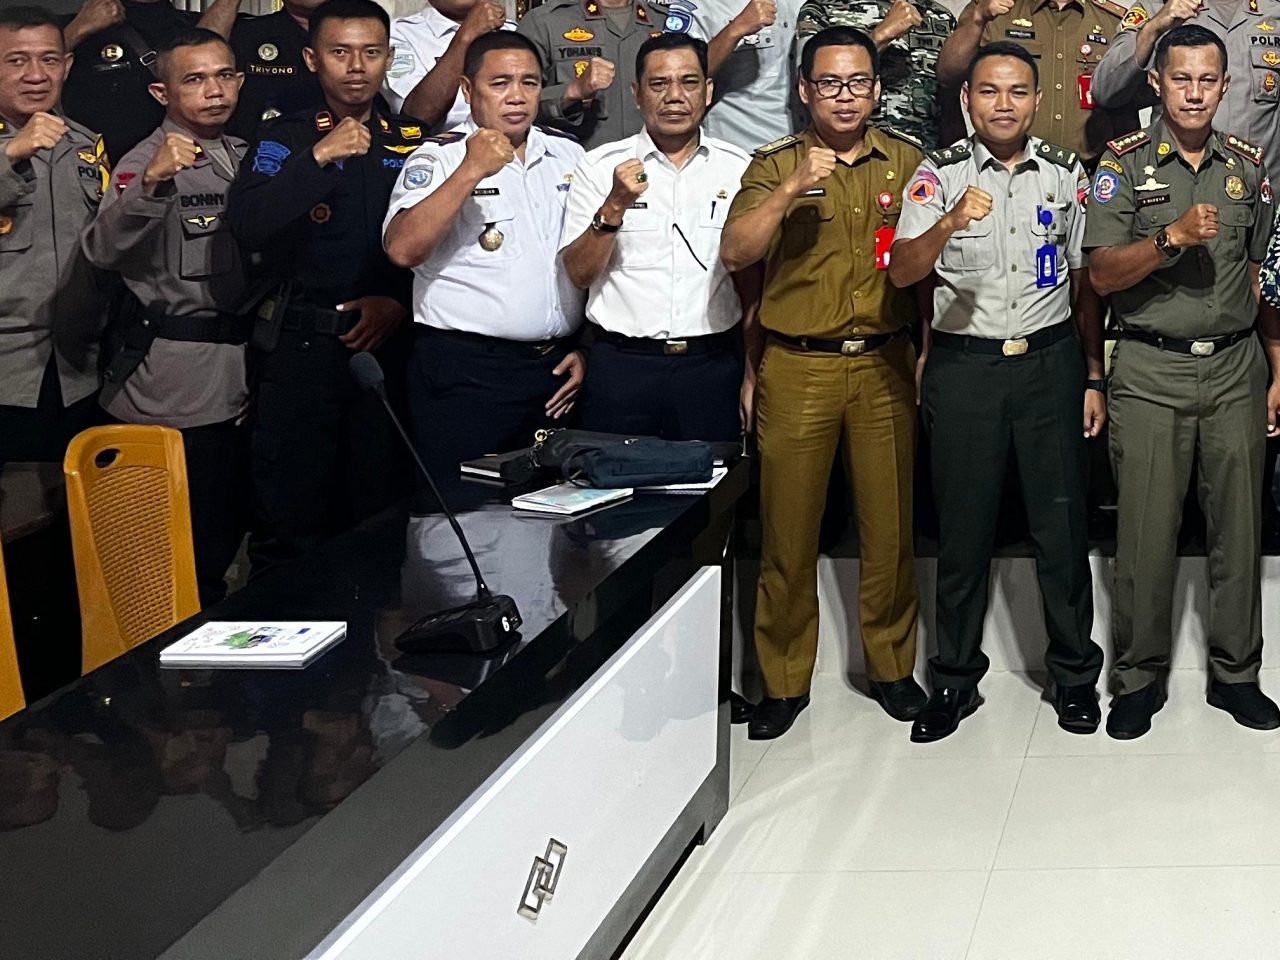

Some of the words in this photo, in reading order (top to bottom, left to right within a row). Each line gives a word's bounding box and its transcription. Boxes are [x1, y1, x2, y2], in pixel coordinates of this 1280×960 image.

[250, 65, 294, 74] TRIYONO
[78, 166, 101, 180] POL
[180, 192, 225, 207] BONNY
